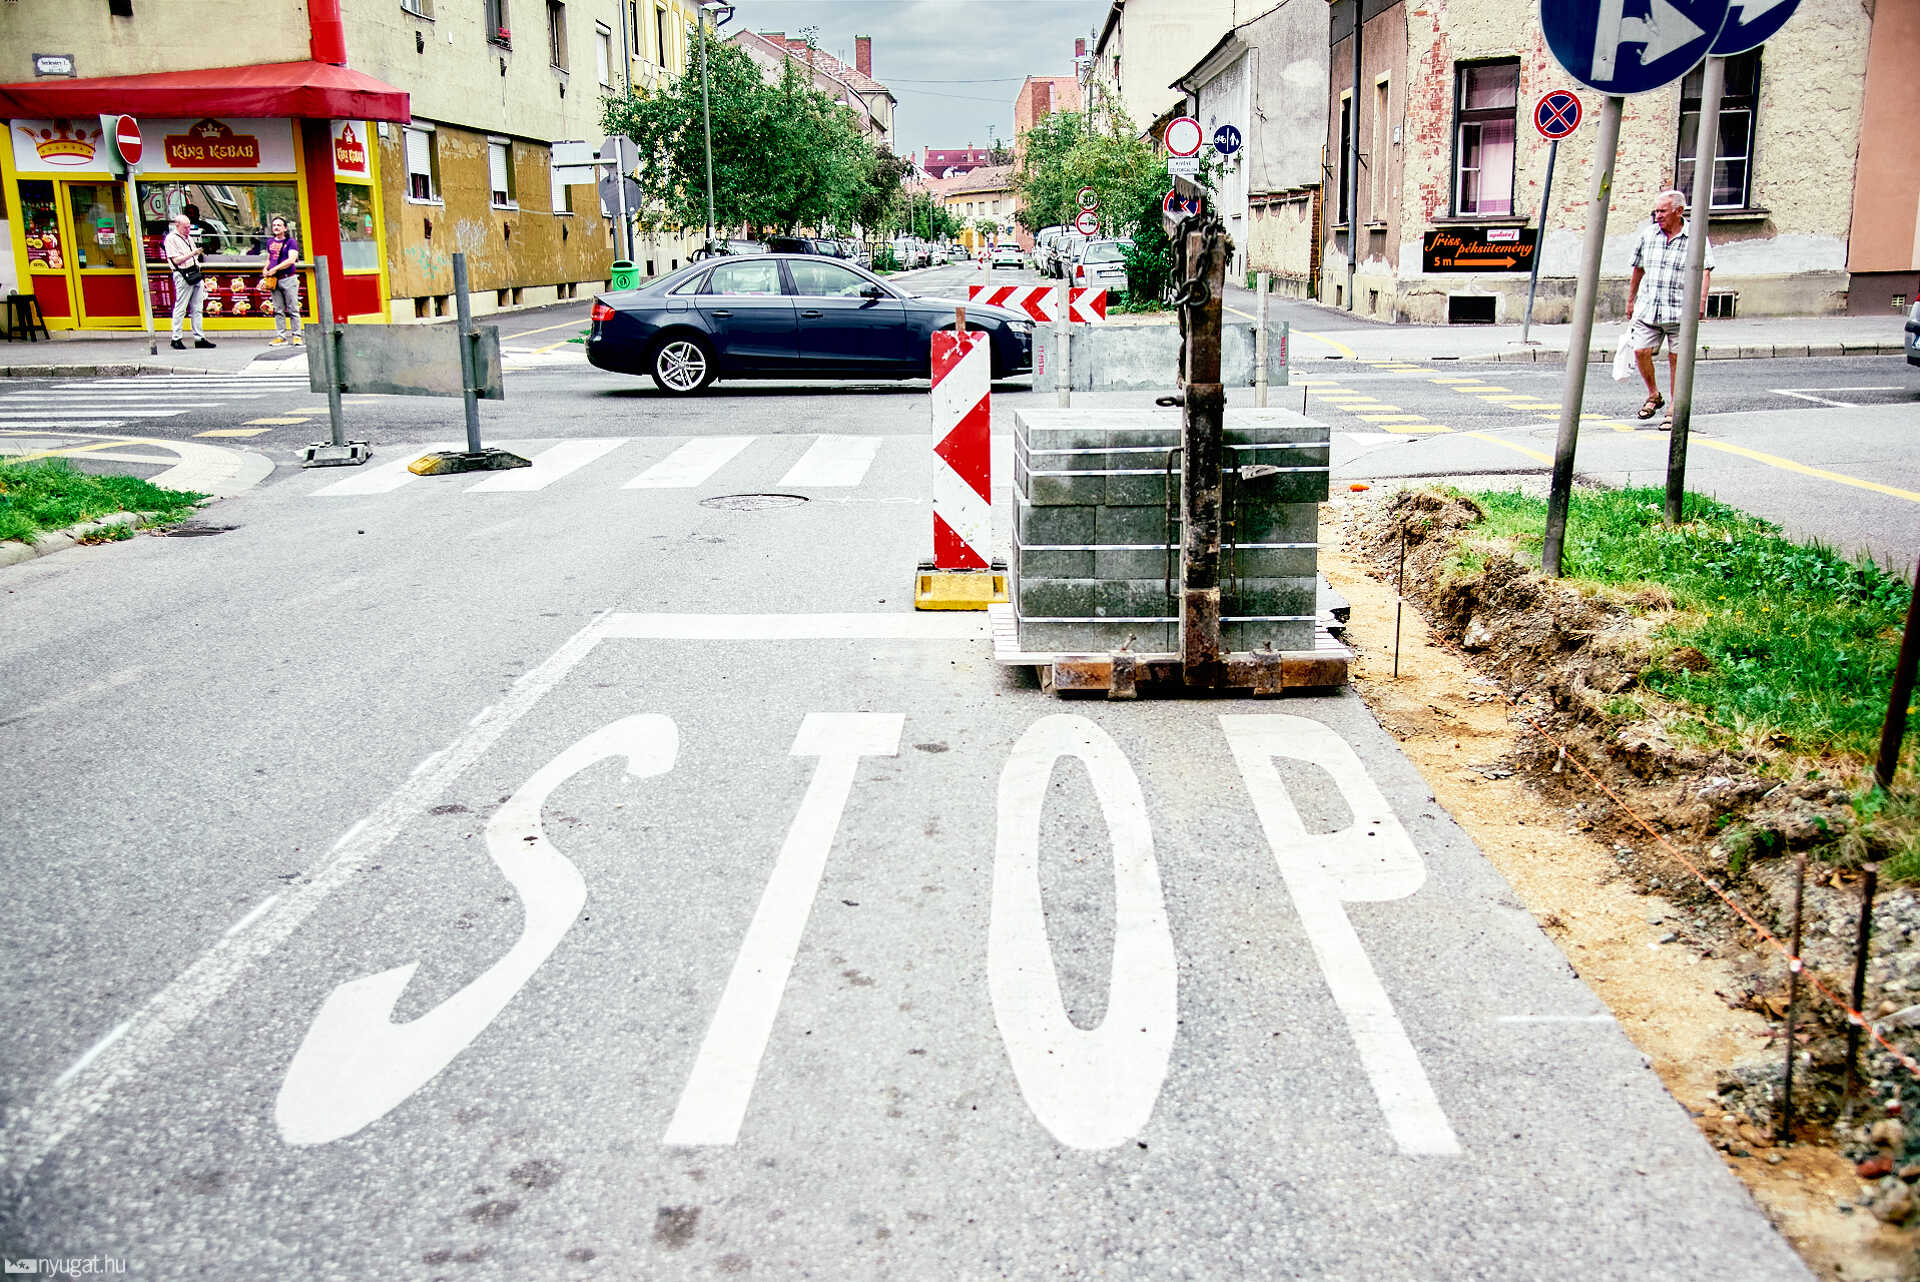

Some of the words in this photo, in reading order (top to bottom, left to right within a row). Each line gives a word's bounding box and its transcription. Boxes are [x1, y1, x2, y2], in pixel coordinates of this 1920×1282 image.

[209, 144, 254, 159] KEBAB
[1424, 232, 1461, 252] friss
[1455, 241, 1534, 257] péksütemény
[1434, 256, 1440, 266] 5
[1443, 257, 1452, 266] m
[274, 711, 1461, 1156] STOP
